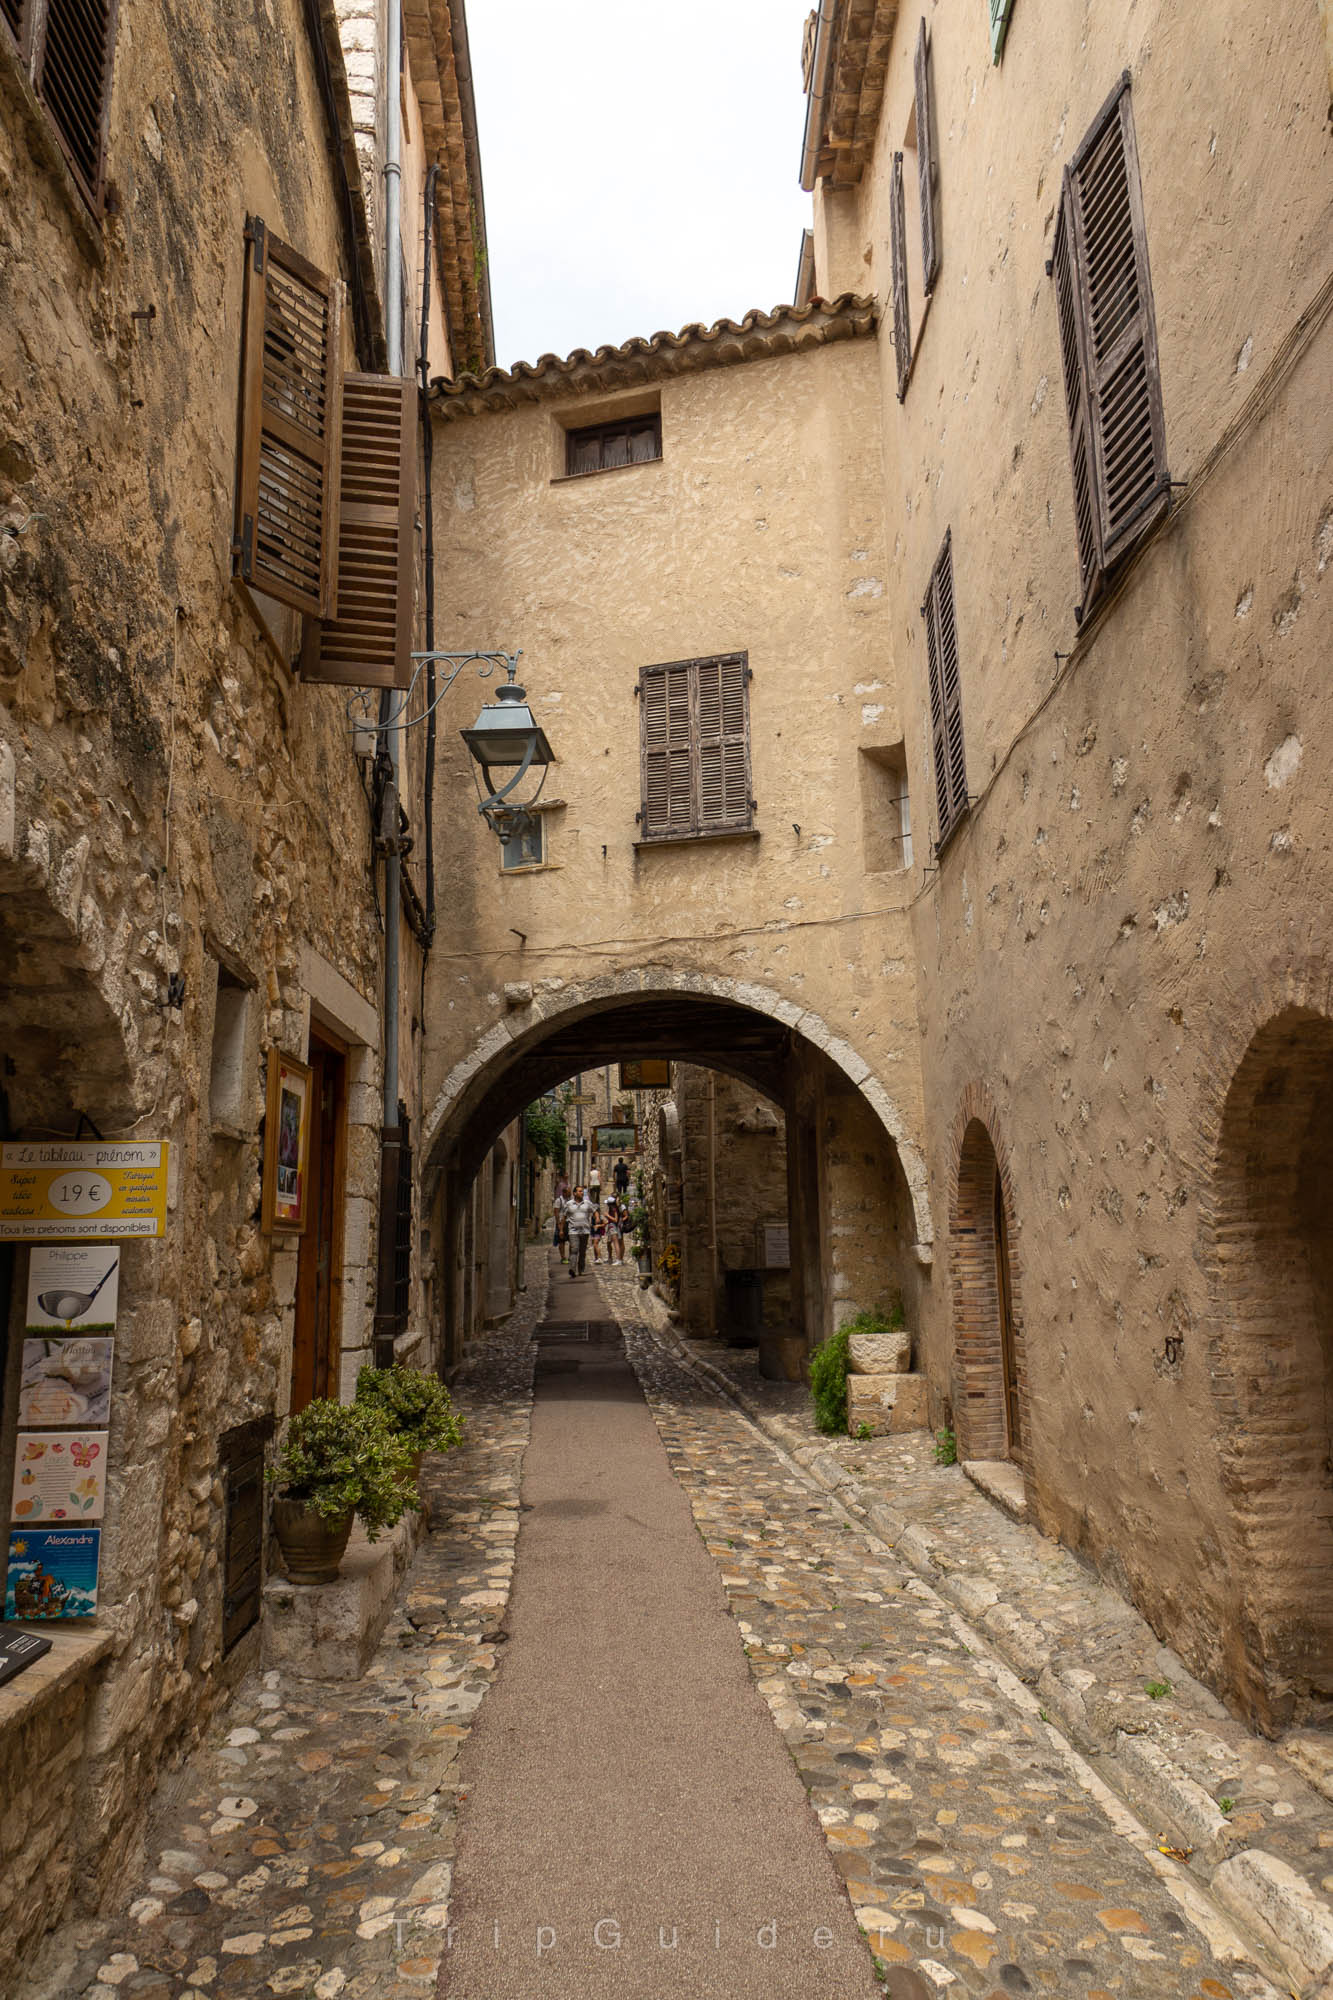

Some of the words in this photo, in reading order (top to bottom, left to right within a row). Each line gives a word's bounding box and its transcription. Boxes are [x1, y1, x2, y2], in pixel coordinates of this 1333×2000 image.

[18, 1147, 34, 1162] Le
[60, 1184, 83, 1202] 19
[88, 1184, 101, 1202] €
[0, 1225, 20, 1235] Tous
[23, 1224, 35, 1234] les
[38, 1223, 76, 1236] prénoms
[78, 1224, 97, 1233] sont
[100, 1222, 150, 1234] disponibles
[48, 1249, 89, 1262] Philippe
[43, 1533, 94, 1545] Alexandre
